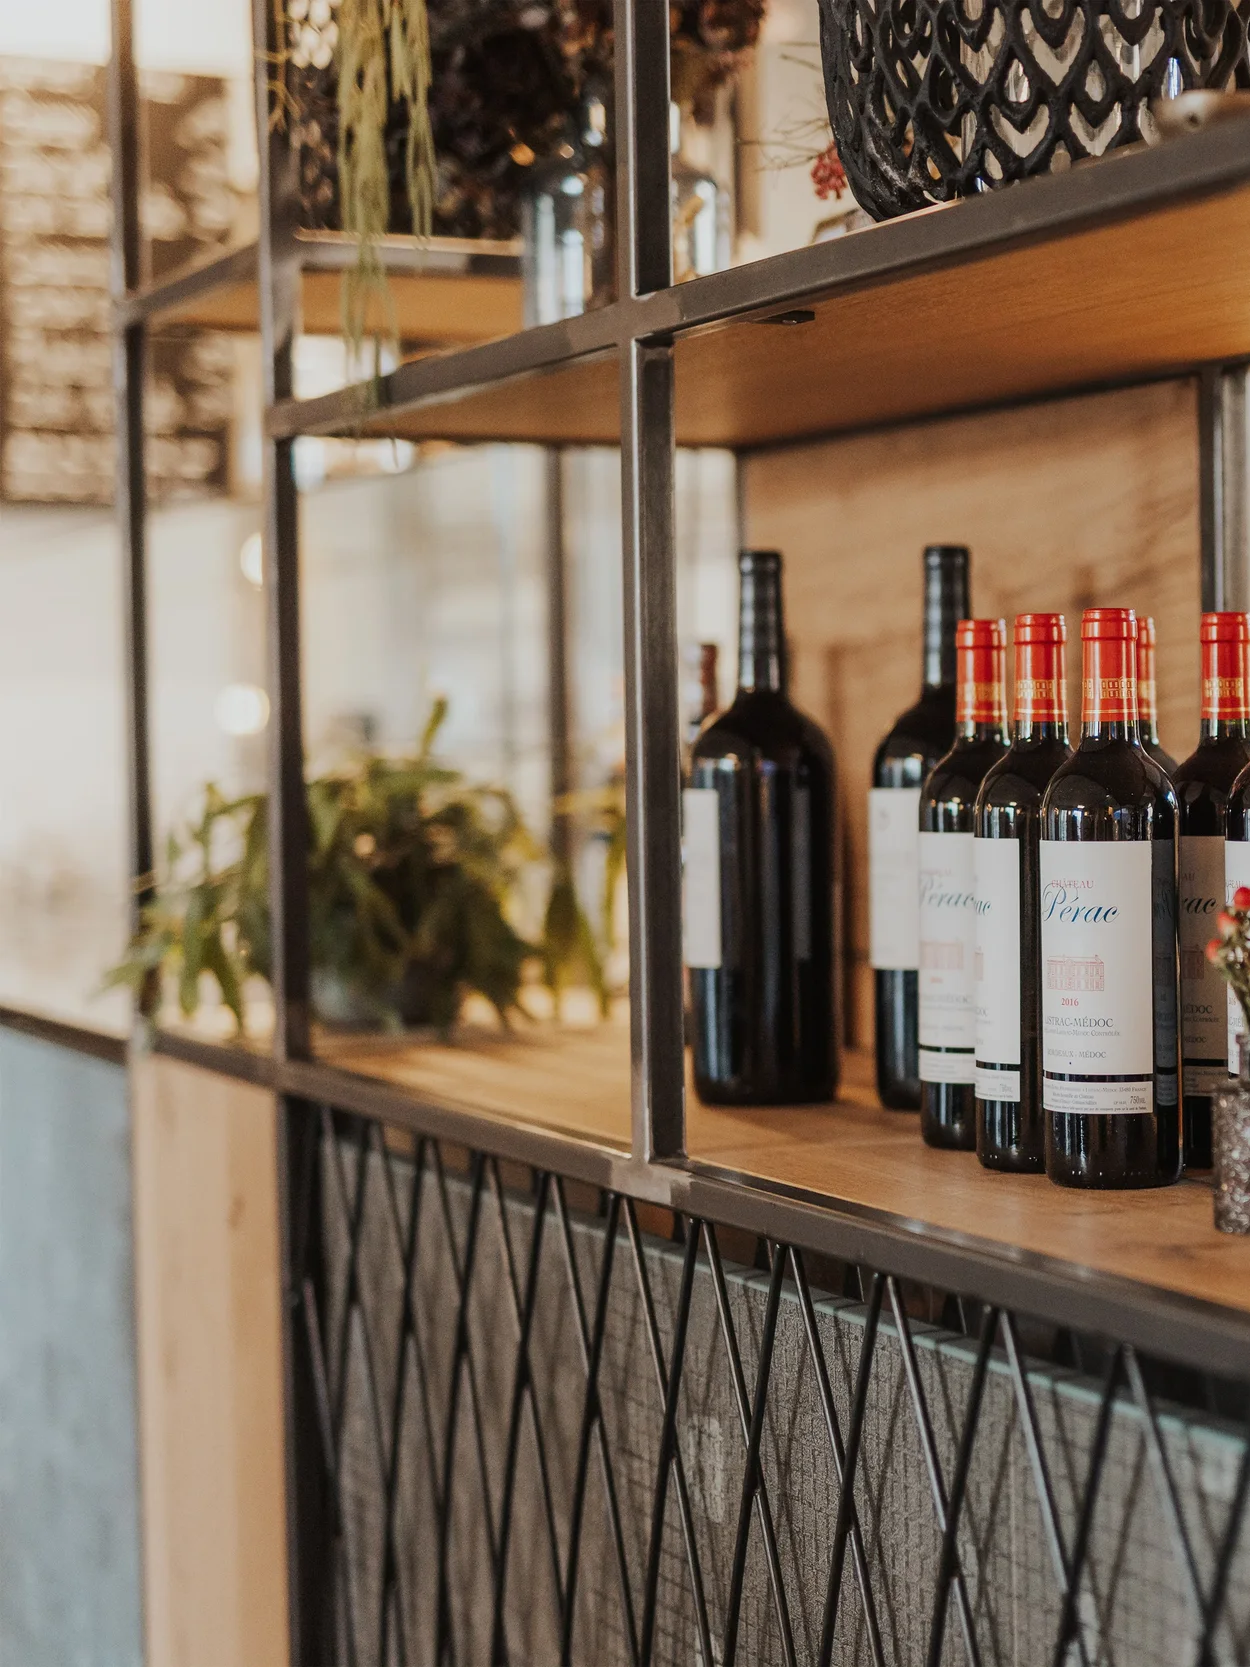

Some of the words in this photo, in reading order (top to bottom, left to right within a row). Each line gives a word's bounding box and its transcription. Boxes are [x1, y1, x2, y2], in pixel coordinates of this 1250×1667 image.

[1051, 879, 1094, 889] CHÂTEAU
[1042, 883, 1120, 924] Pérac
[1061, 998, 1079, 1007] 2016
